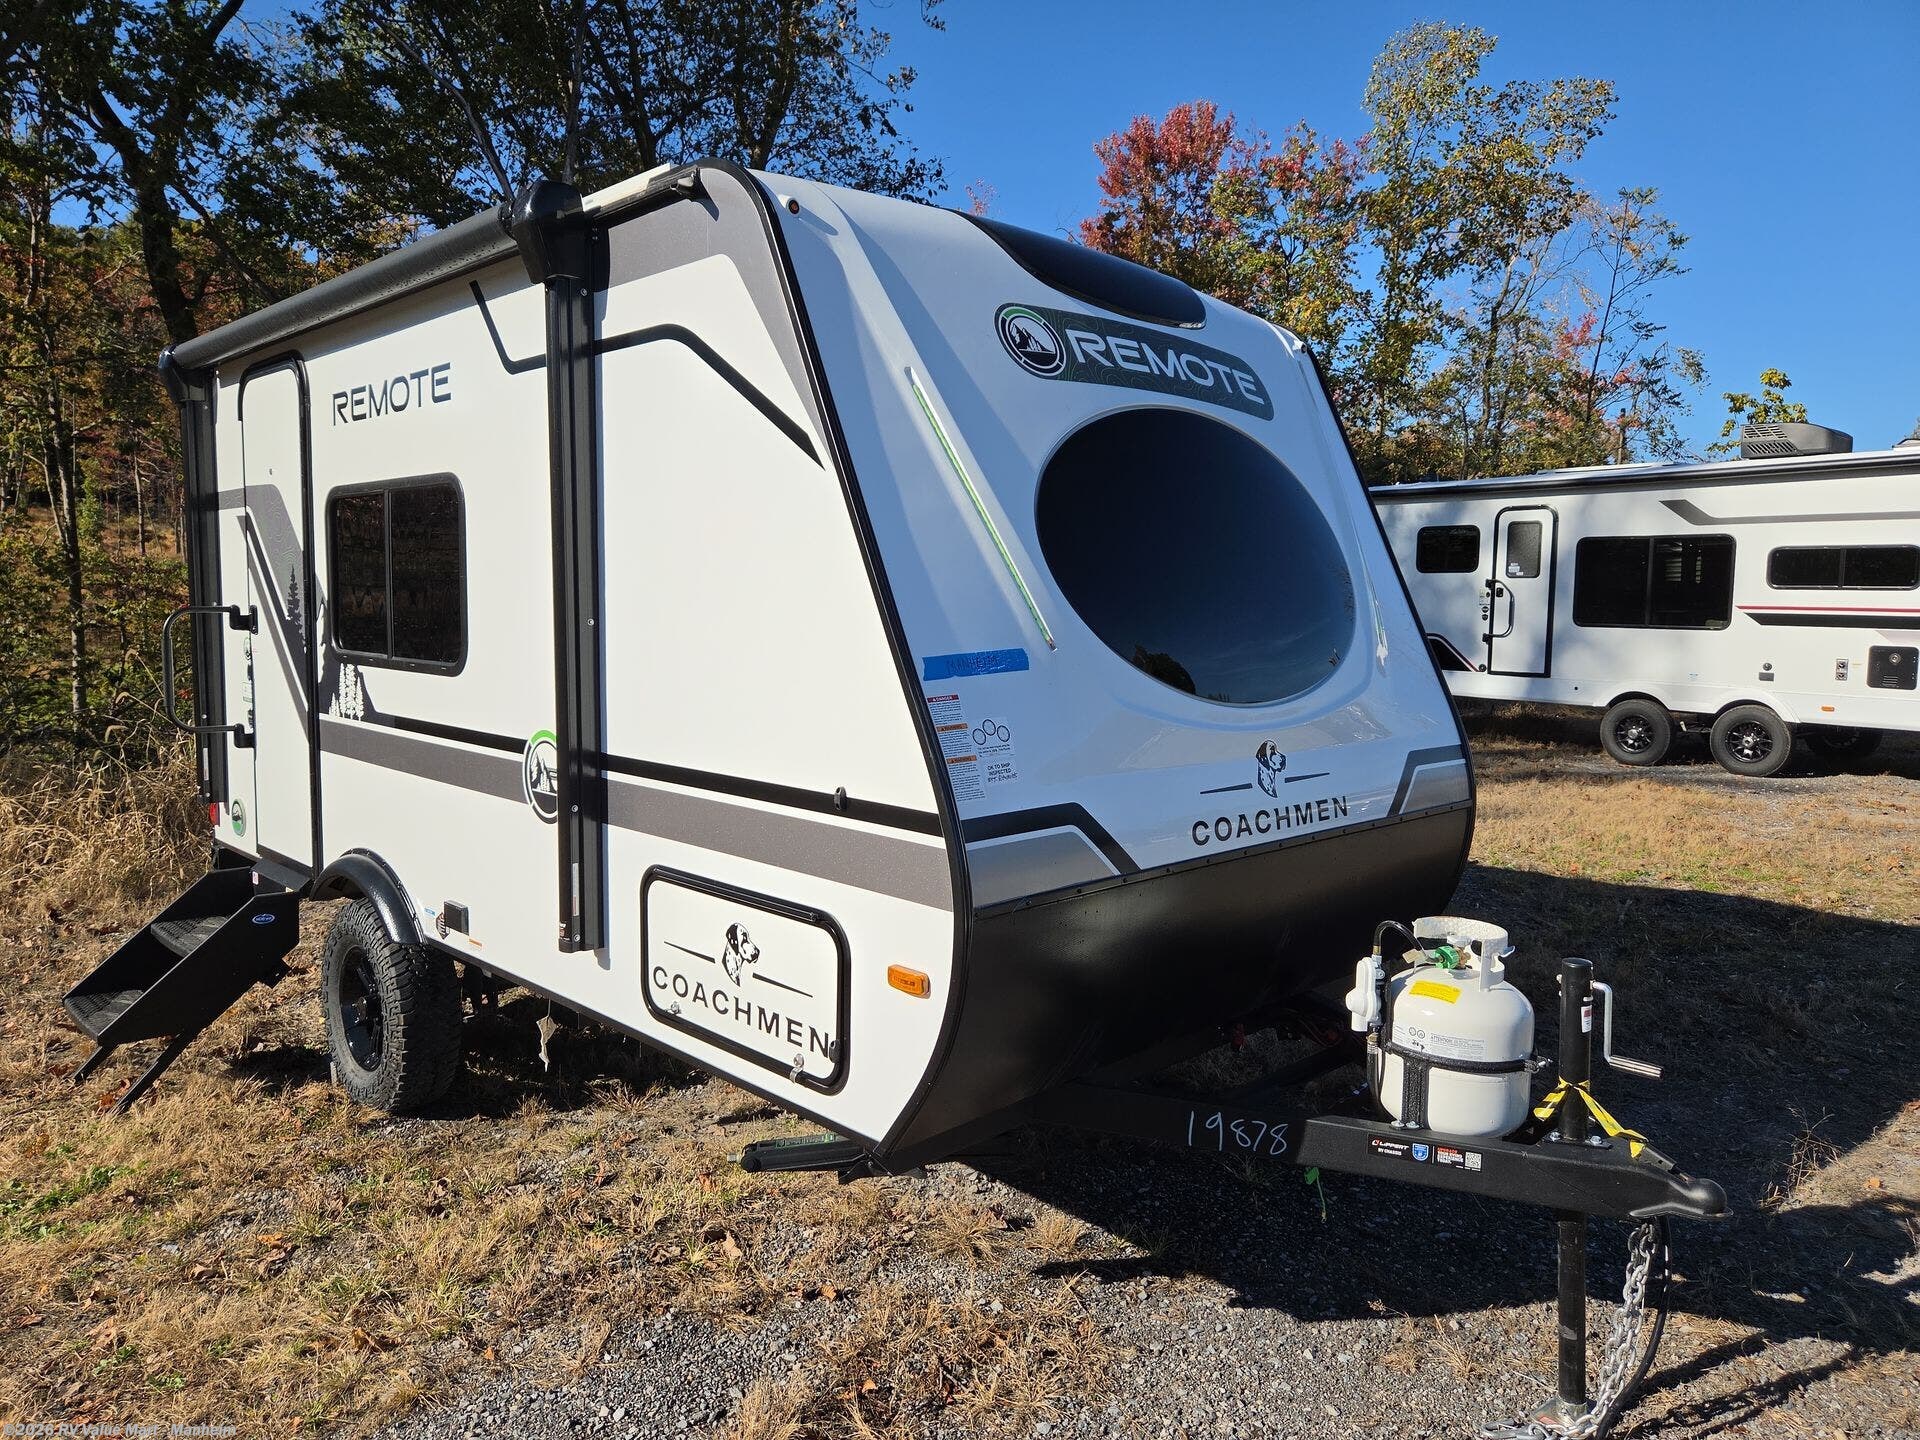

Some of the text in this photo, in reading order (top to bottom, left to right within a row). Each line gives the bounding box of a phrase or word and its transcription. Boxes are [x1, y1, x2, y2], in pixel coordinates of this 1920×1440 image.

[332, 362, 452, 426] REMOTE
[1065, 328, 1265, 405] REMOTE
[1191, 795, 1349, 846] COACHMEN
[652, 966, 829, 1059] COACHMEN
[1188, 1110, 1289, 1156] 19878
